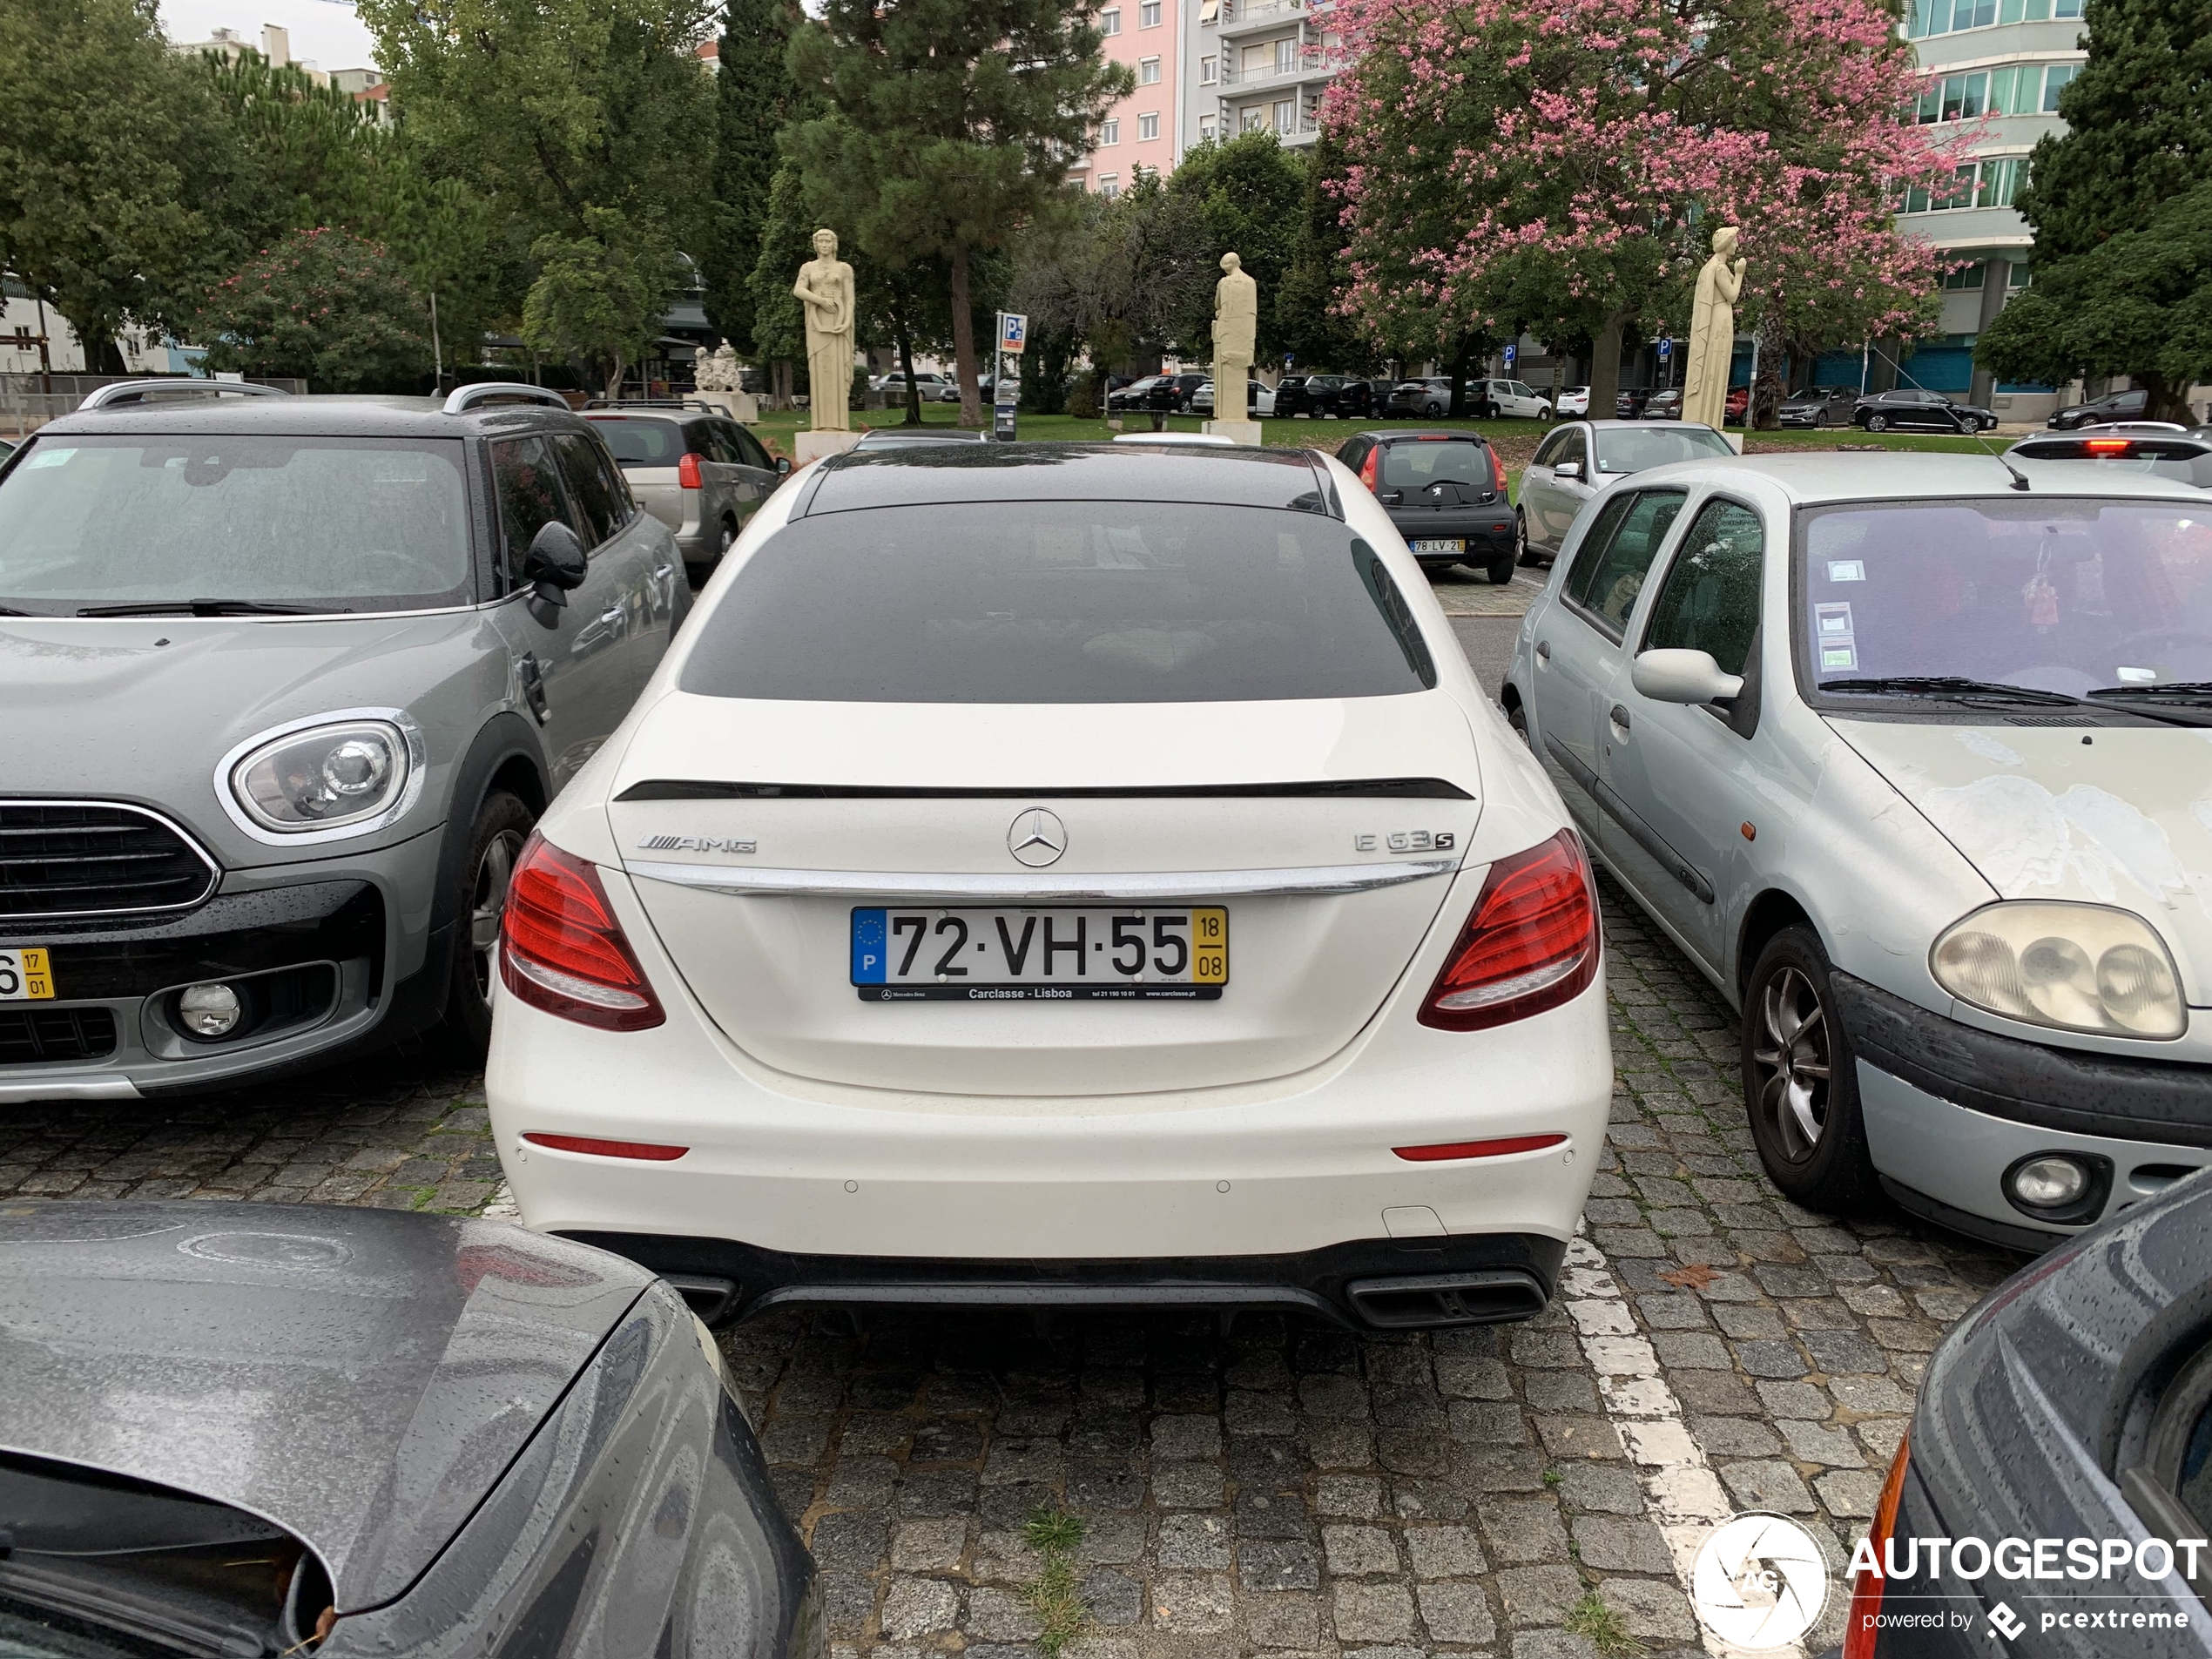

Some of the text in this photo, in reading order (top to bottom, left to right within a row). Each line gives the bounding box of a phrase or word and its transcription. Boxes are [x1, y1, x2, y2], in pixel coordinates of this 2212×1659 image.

[1007, 319, 1017, 339] P
[1505, 347, 1514, 359] P
[1660, 340, 1669, 354] P
[673, 836, 757, 853] AMG
[1355, 833, 1377, 851] E
[1200, 917, 1219, 937] 18
[24, 954, 38, 968] 17
[863, 954, 876, 971] P
[1199, 956, 1222, 976] 08
[30, 981, 45, 994] 01
[968, 988, 1024, 999] Carclasse
[1035, 988, 1072, 998] Lisboa
